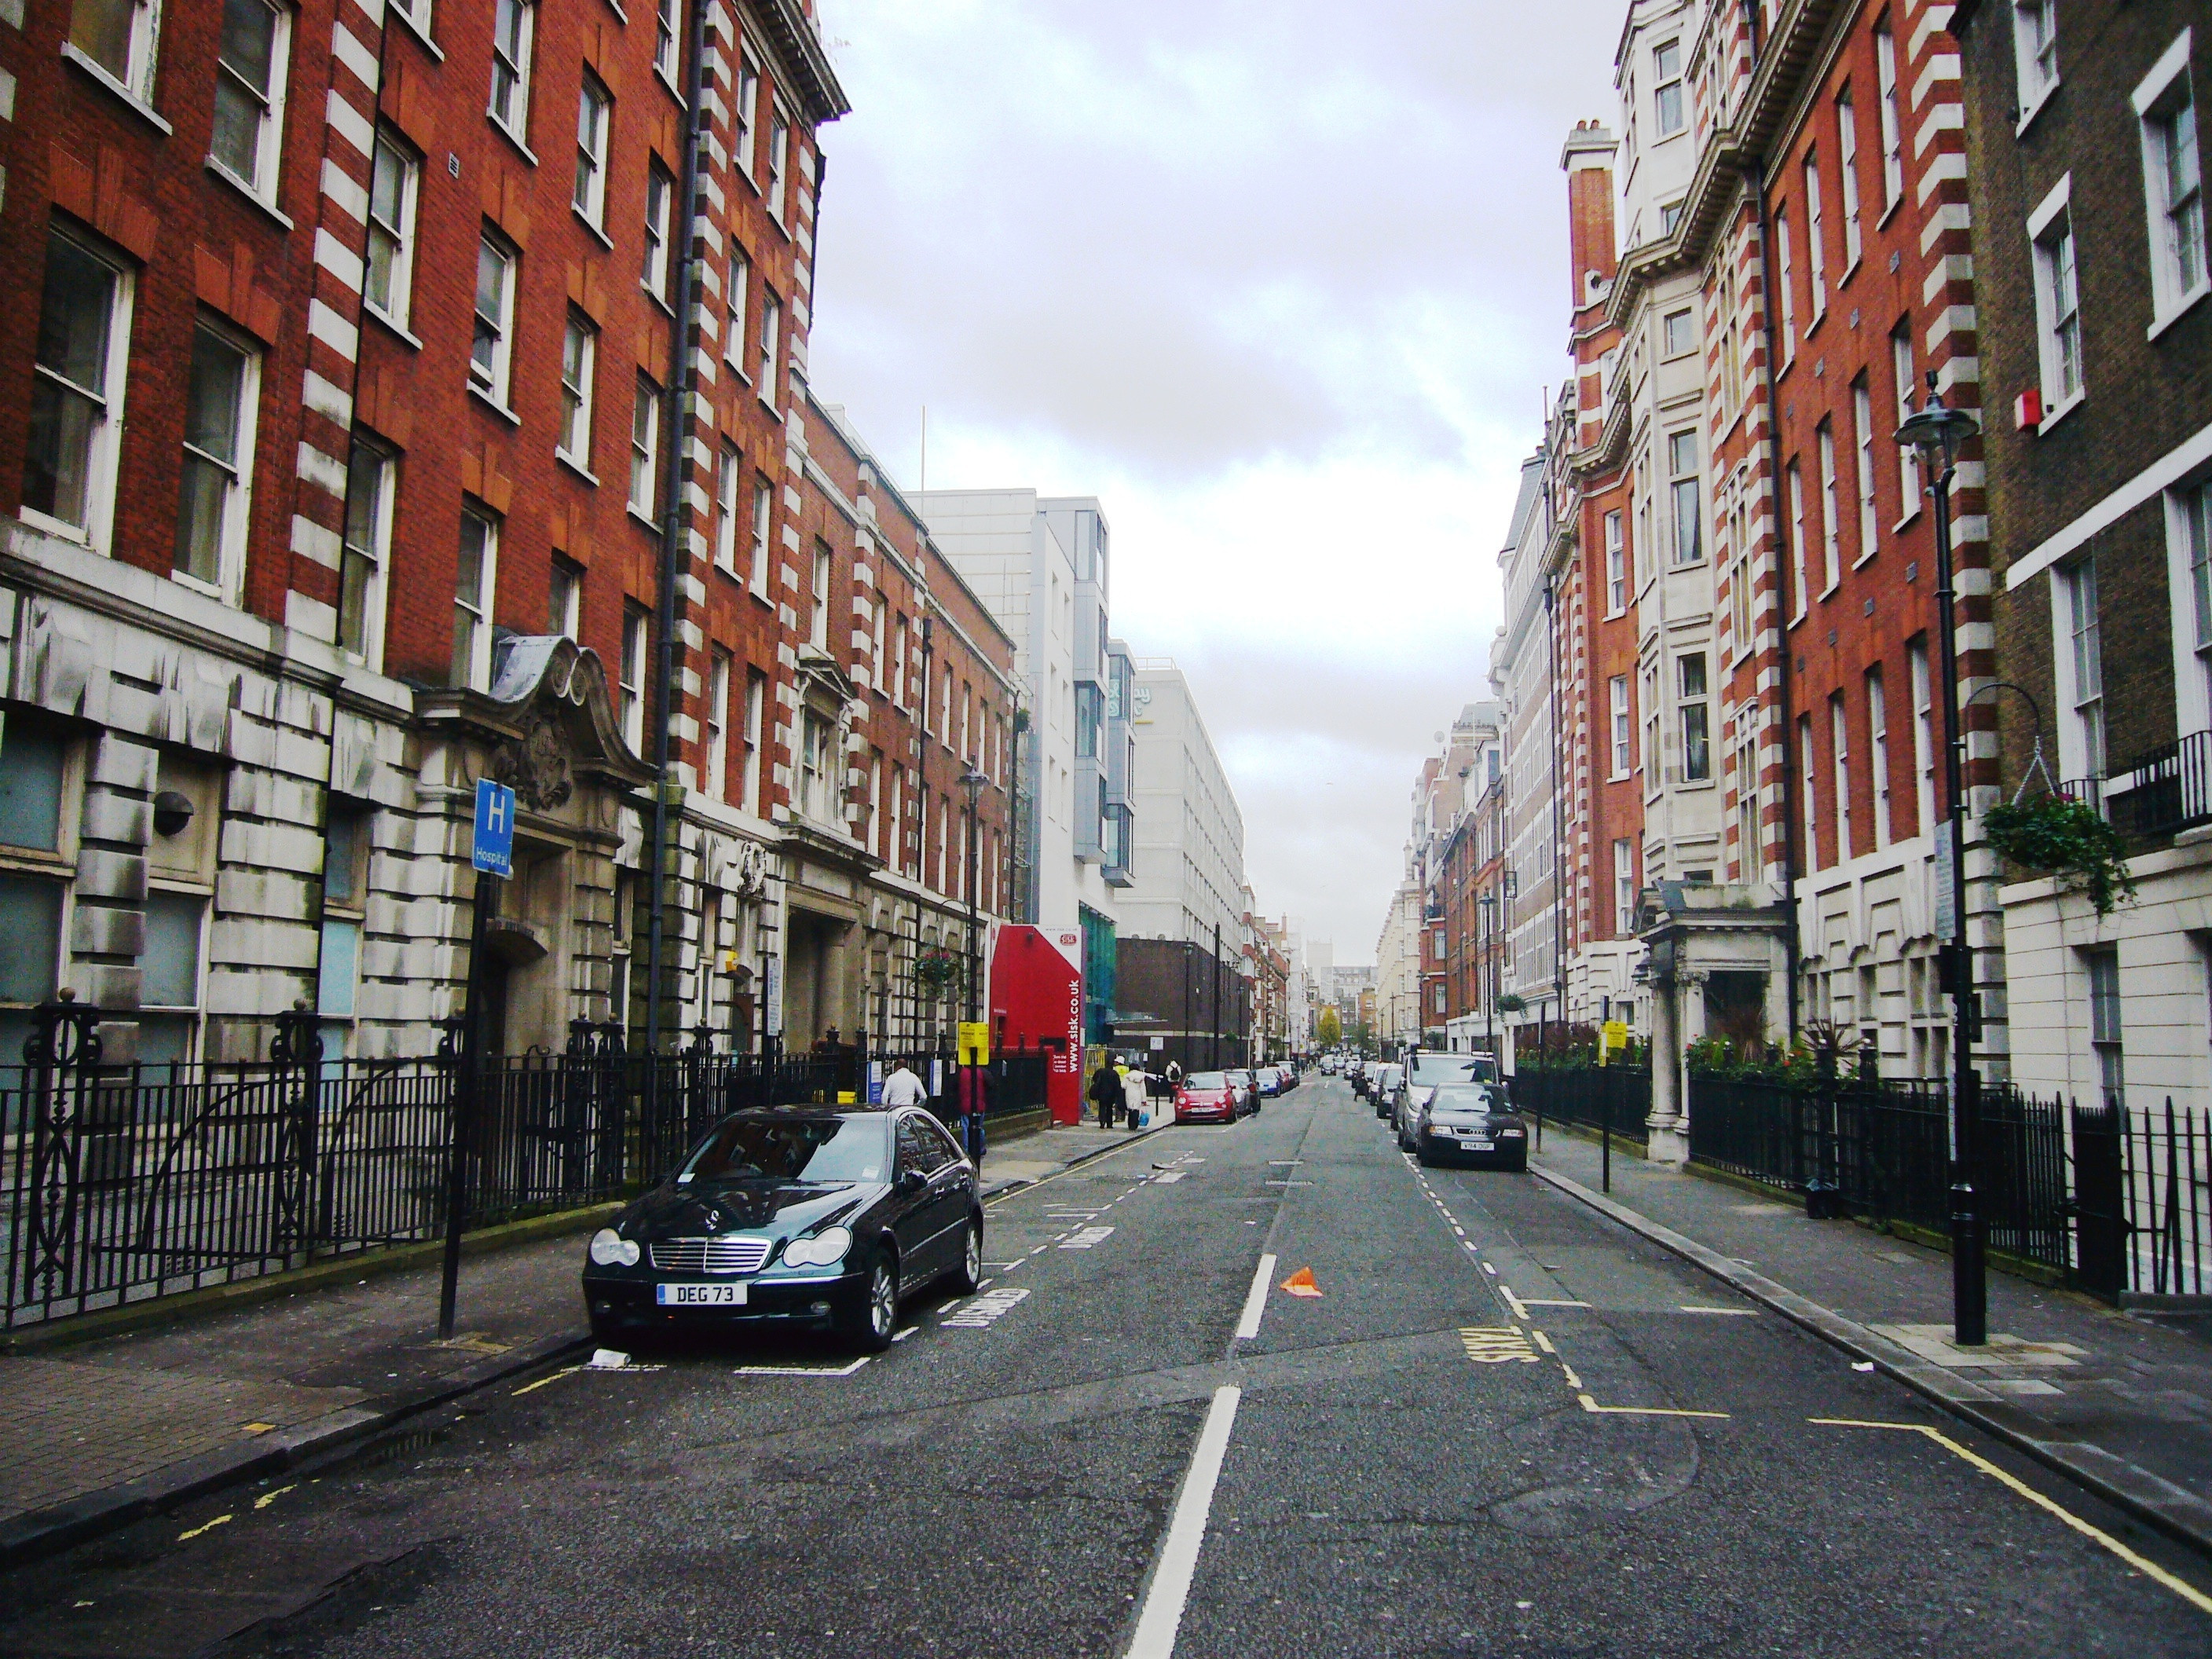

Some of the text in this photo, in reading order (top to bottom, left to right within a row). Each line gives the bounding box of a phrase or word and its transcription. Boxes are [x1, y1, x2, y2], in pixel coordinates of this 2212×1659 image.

[488, 792, 505, 833] H
[476, 847, 508, 866] Hospital
[1068, 980, 1079, 1072] www.sisk.co.uk
[677, 1287, 734, 1302] DEG 73
[1458, 1325, 1540, 1363] TAXIS
